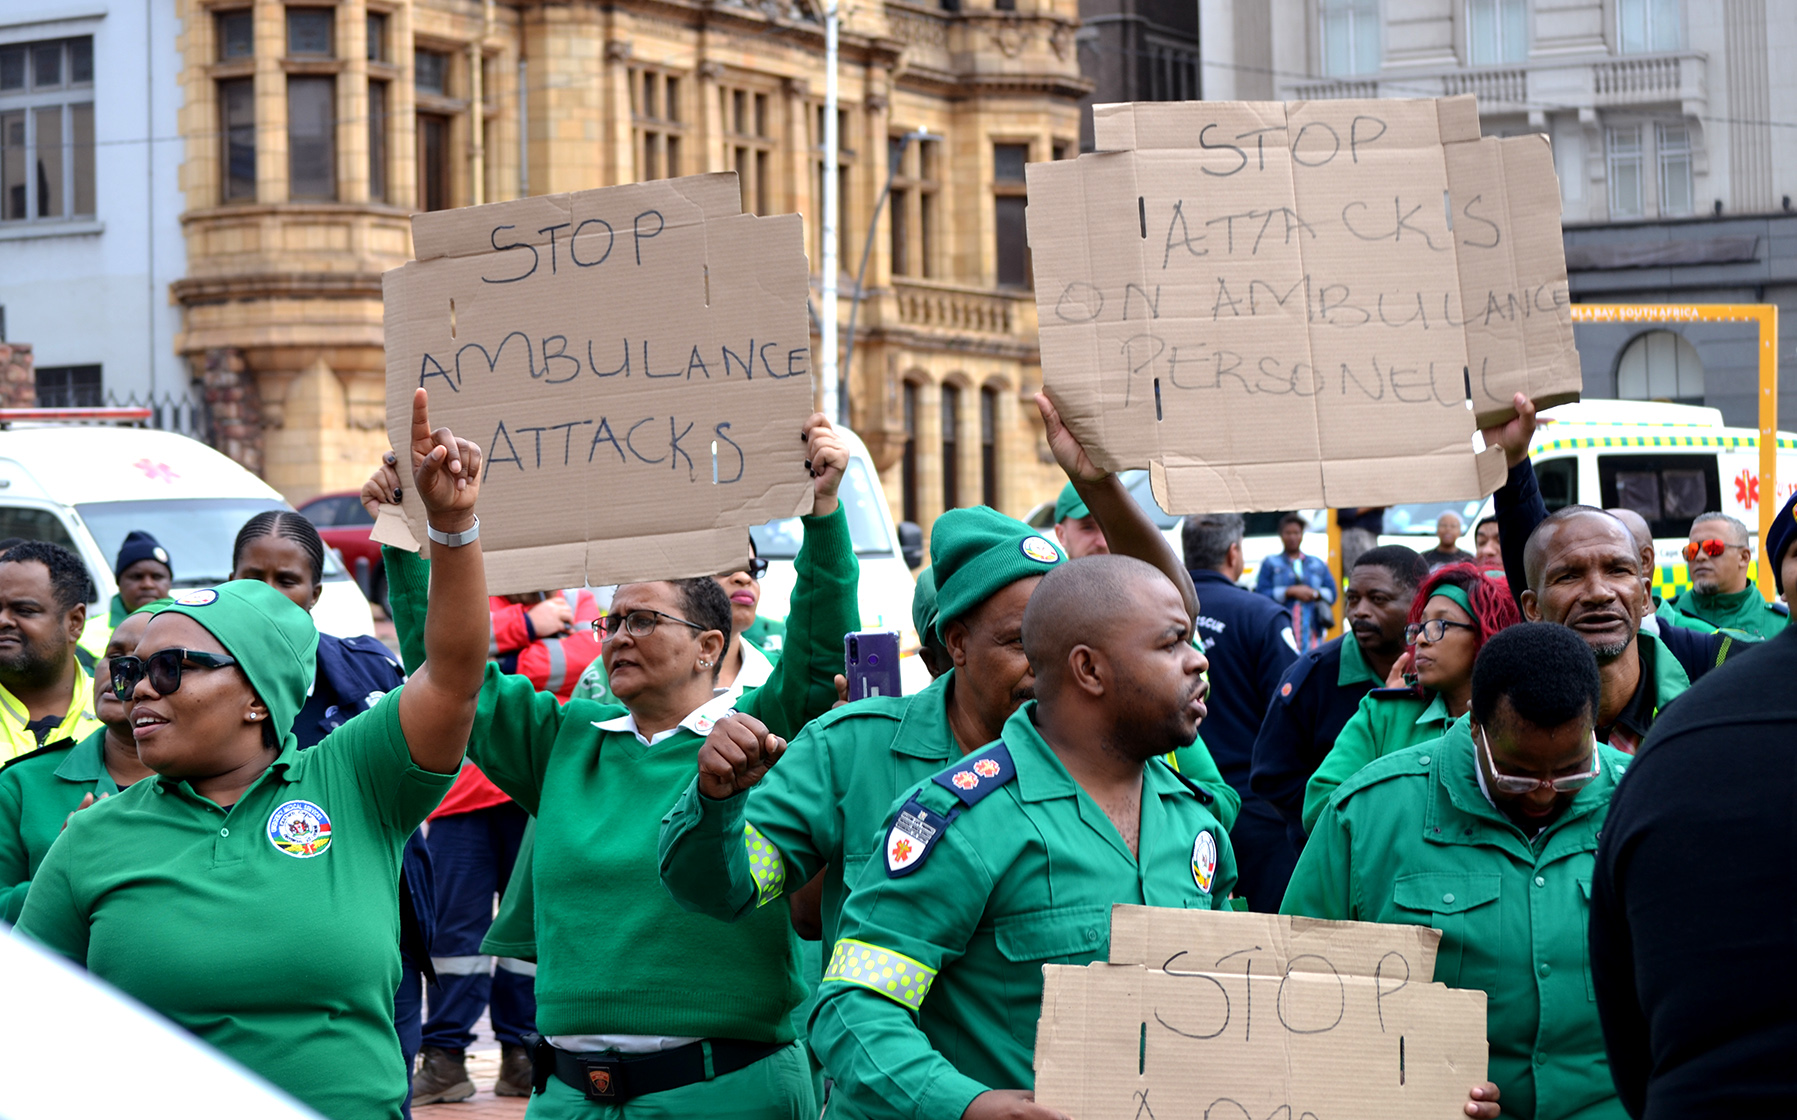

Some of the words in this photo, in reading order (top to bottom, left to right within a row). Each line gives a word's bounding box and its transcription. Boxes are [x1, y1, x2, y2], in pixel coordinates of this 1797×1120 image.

[1199, 115, 1387, 176] STOP
[482, 210, 664, 283] STOP
[1163, 195, 1500, 269] ATTACKS
[1055, 282, 1161, 322] ON
[1212, 275, 1570, 330] AMBULANCE
[1571, 307, 1592, 317] ELA
[1619, 307, 1657, 317] SOUTH
[1659, 307, 1699, 317] AFRICA
[418, 331, 808, 393] AMBULANCE
[482, 416, 745, 484] ATTACKS
[1154, 946, 1410, 1042] STOP
